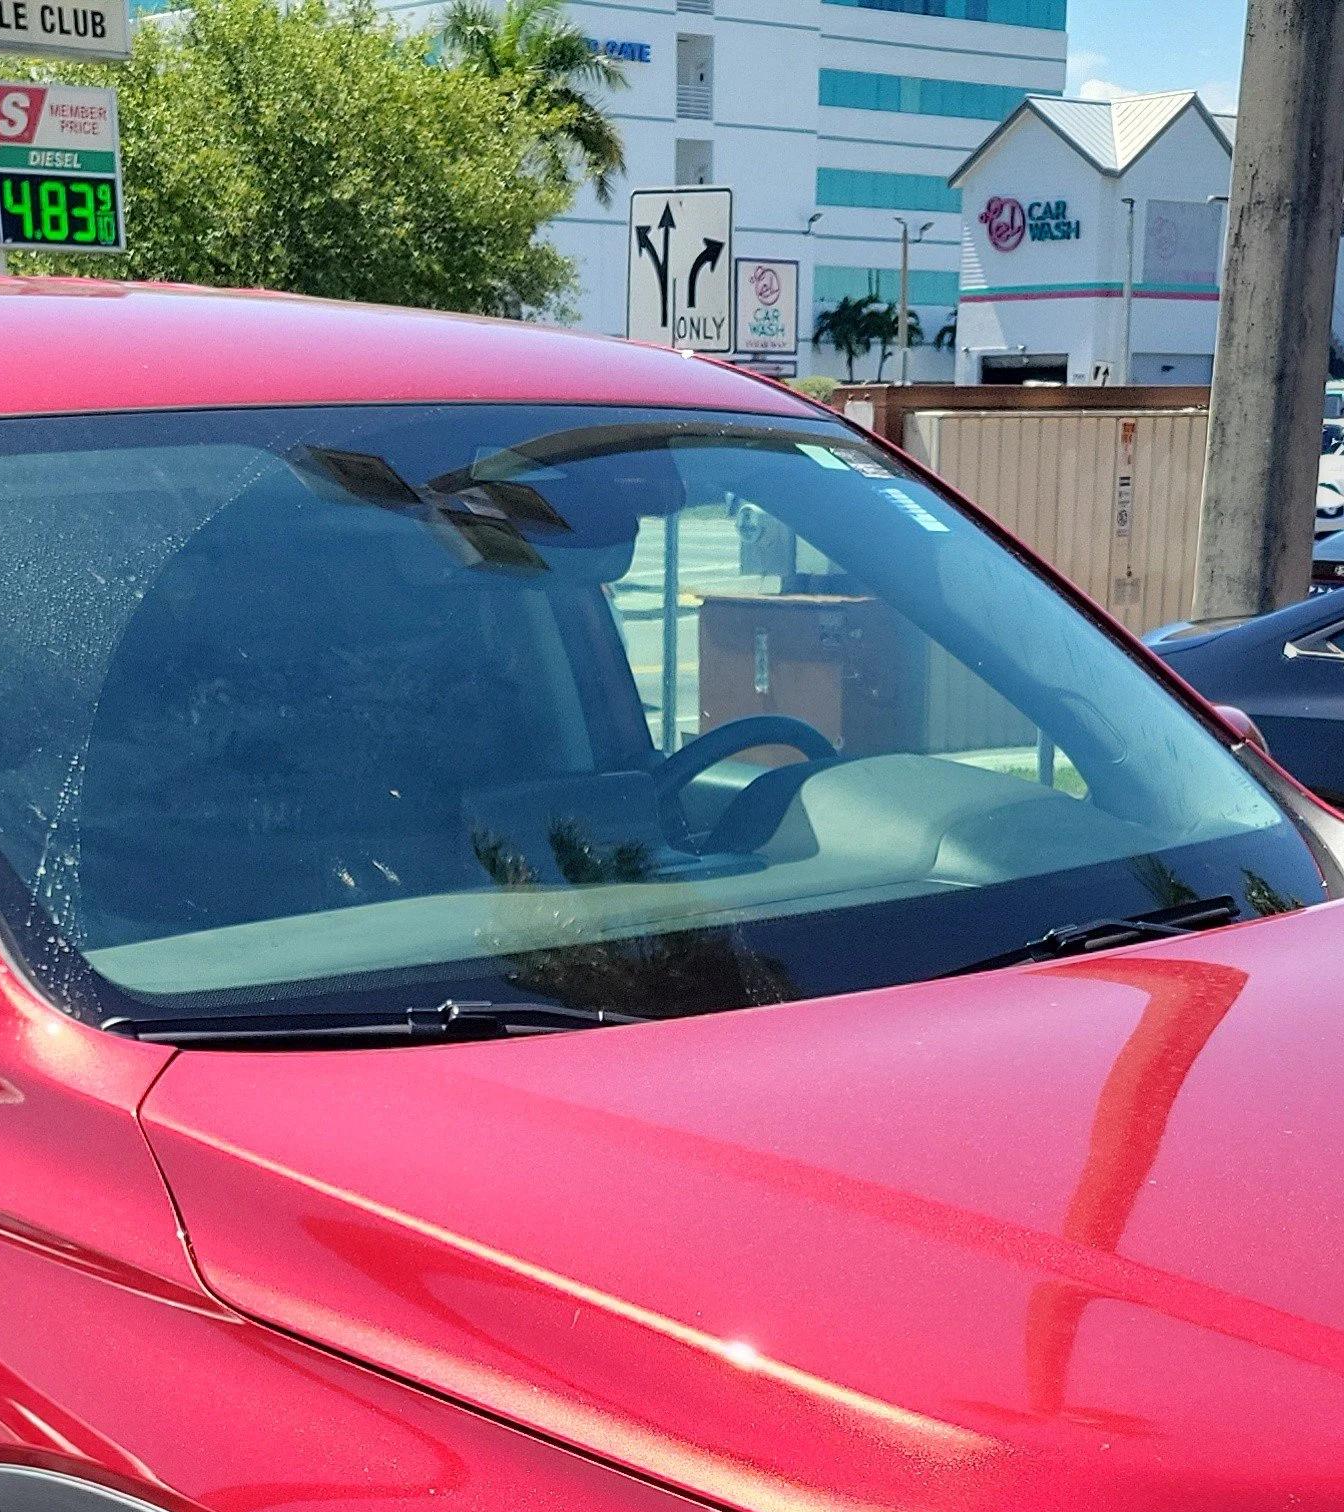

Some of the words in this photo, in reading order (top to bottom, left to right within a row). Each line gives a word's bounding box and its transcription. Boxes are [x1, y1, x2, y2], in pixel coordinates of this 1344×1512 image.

[40, 4, 106, 38] CLUB
[49, 103, 108, 121] MEMBER
[59, 120, 100, 136] PRICE
[28, 150, 82, 169] DIESEL
[2, 179, 96, 242] 4.83
[1027, 200, 1067, 221] CAR
[1029, 220, 1080, 242] WASH
[676, 316, 725, 341] ONLY
